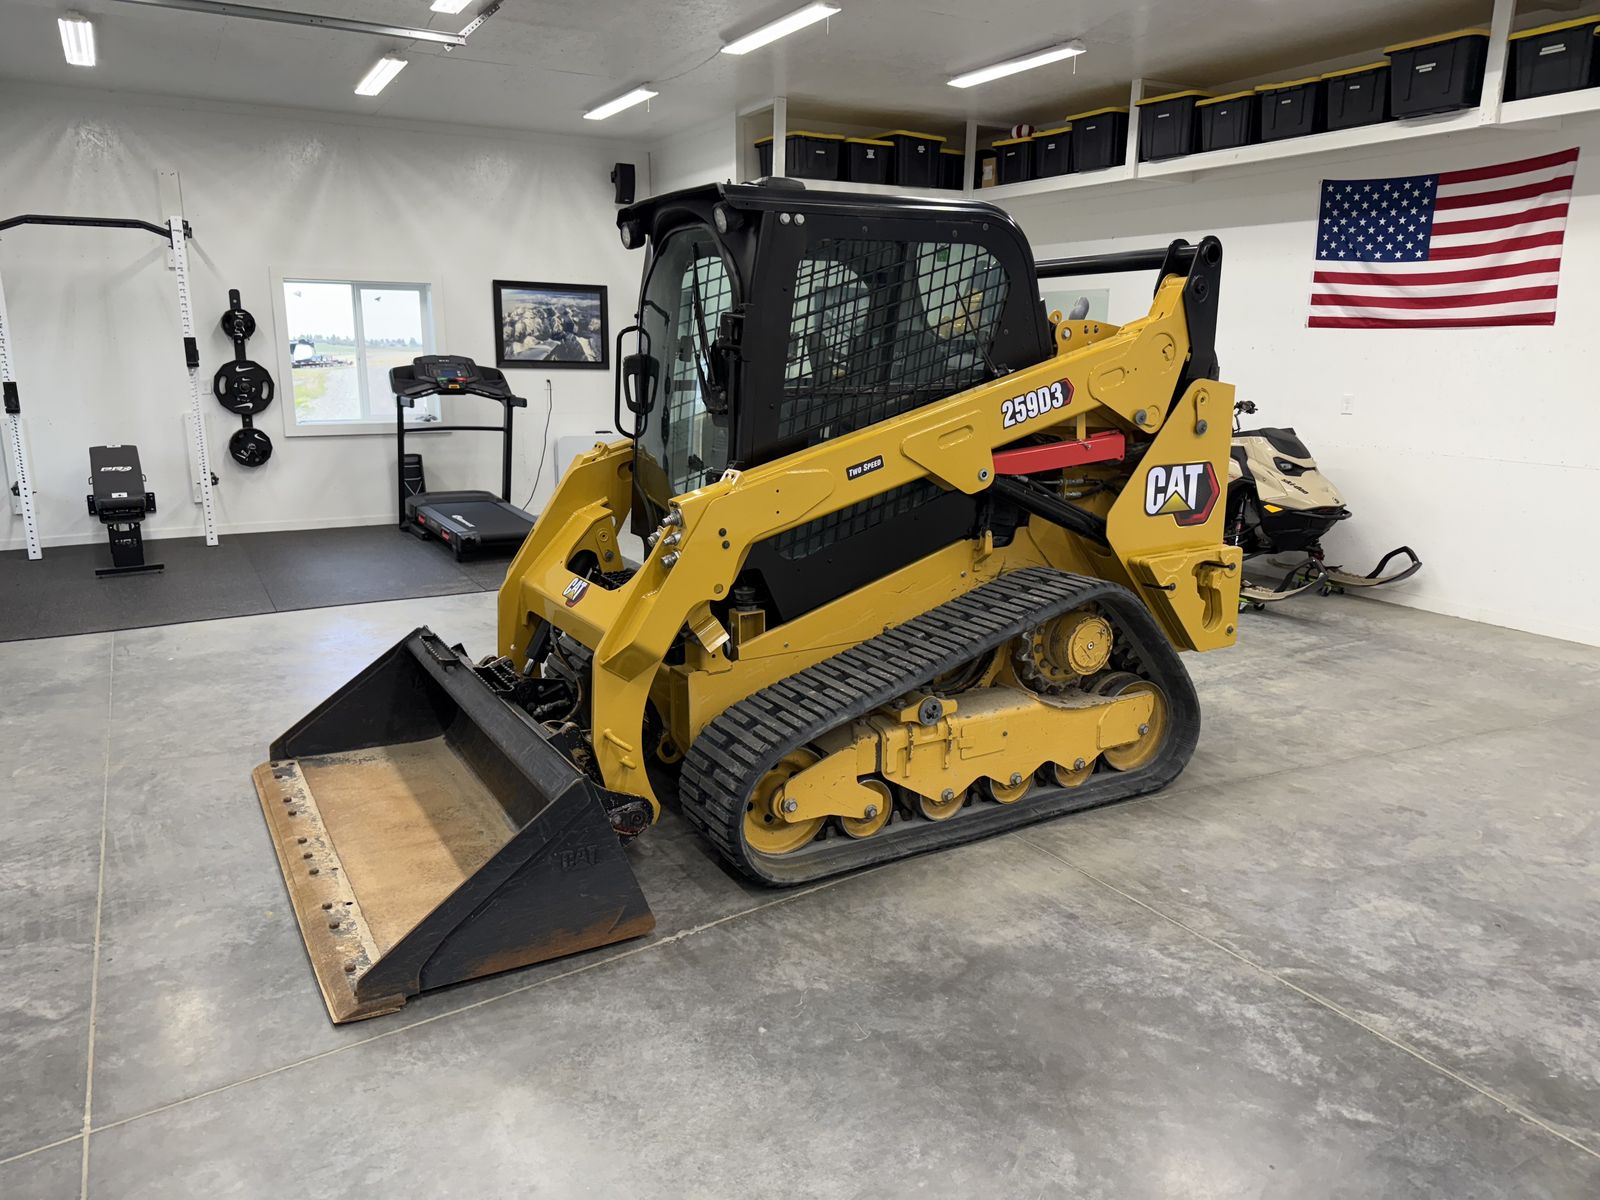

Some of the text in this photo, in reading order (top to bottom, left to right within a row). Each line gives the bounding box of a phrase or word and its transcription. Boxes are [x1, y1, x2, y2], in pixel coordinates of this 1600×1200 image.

[1001, 381, 1064, 429] 259D3
[1145, 464, 1204, 515] CAT
[563, 577, 588, 601] CAT
[560, 844, 600, 871] CAT
